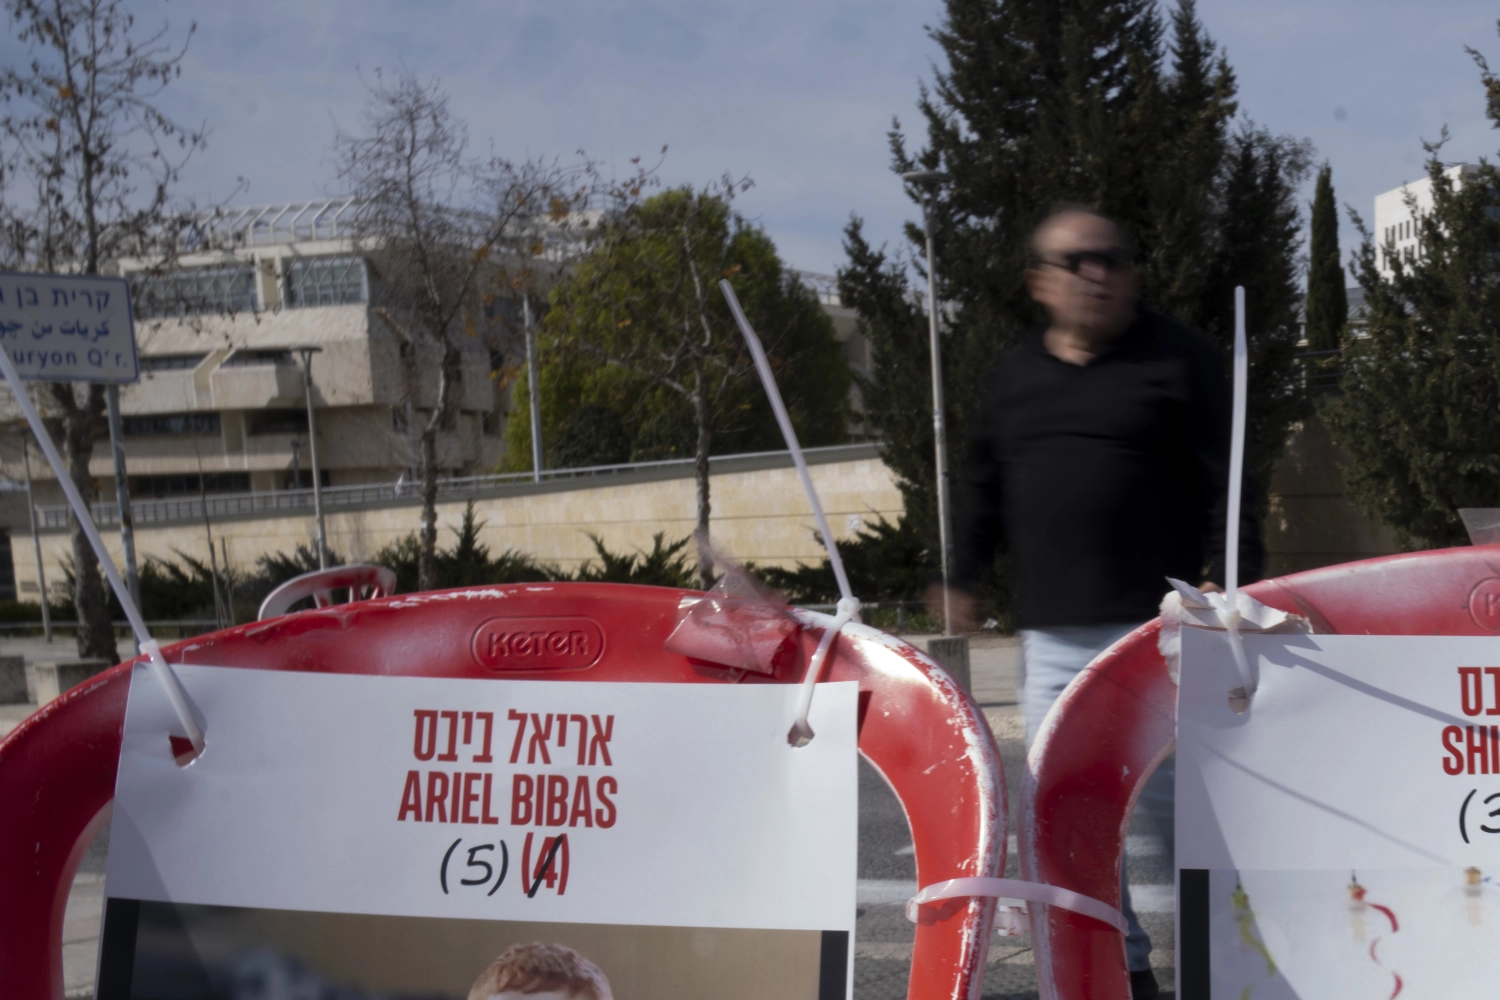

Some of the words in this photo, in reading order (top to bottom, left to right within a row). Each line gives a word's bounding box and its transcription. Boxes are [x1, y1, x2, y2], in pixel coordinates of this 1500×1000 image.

[16, 286, 39, 309] בן
[51, 287, 110, 313] קרית
[13, 350, 77, 369] uryon
[413, 709, 494, 763] ביבס
[508, 709, 615, 766] אריאל
[397, 770, 499, 825] ARIEL
[510, 773, 618, 829] BIBAS
[440, 838, 509, 897] (5)
